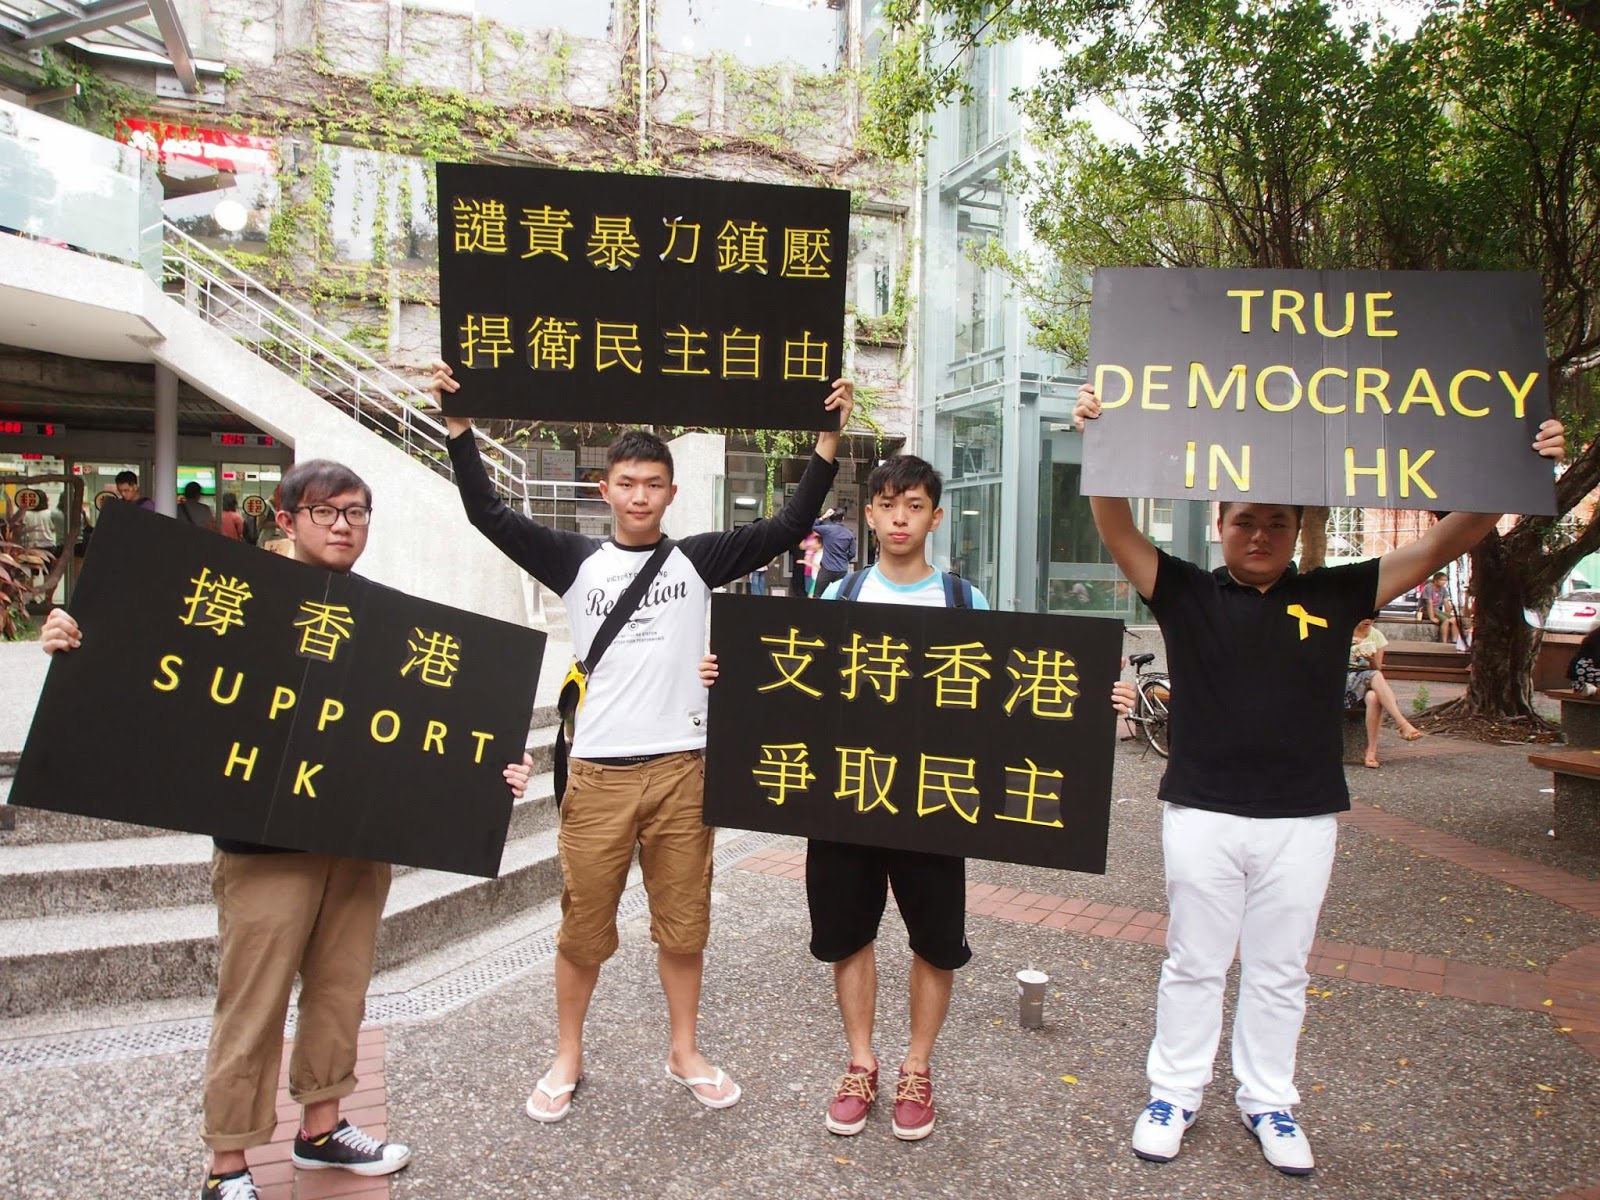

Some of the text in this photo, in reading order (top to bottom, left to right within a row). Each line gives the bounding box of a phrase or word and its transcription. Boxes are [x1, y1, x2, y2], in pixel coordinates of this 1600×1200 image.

[454, 198, 832, 280] 譴責暴力鎮壓
[459, 313, 829, 381] 捍衛民主自由
[1227, 289, 1399, 338] TRUE
[1094, 361, 1540, 419] DEMOCRACY
[1184, 442, 1438, 500] IN HK
[178, 567, 462, 688] 撐香港
[152, 654, 495, 764] SUPPORT
[757, 627, 1080, 719] 支持香港
[223, 741, 324, 798] HK
[752, 742, 1065, 829] 爭取民主
